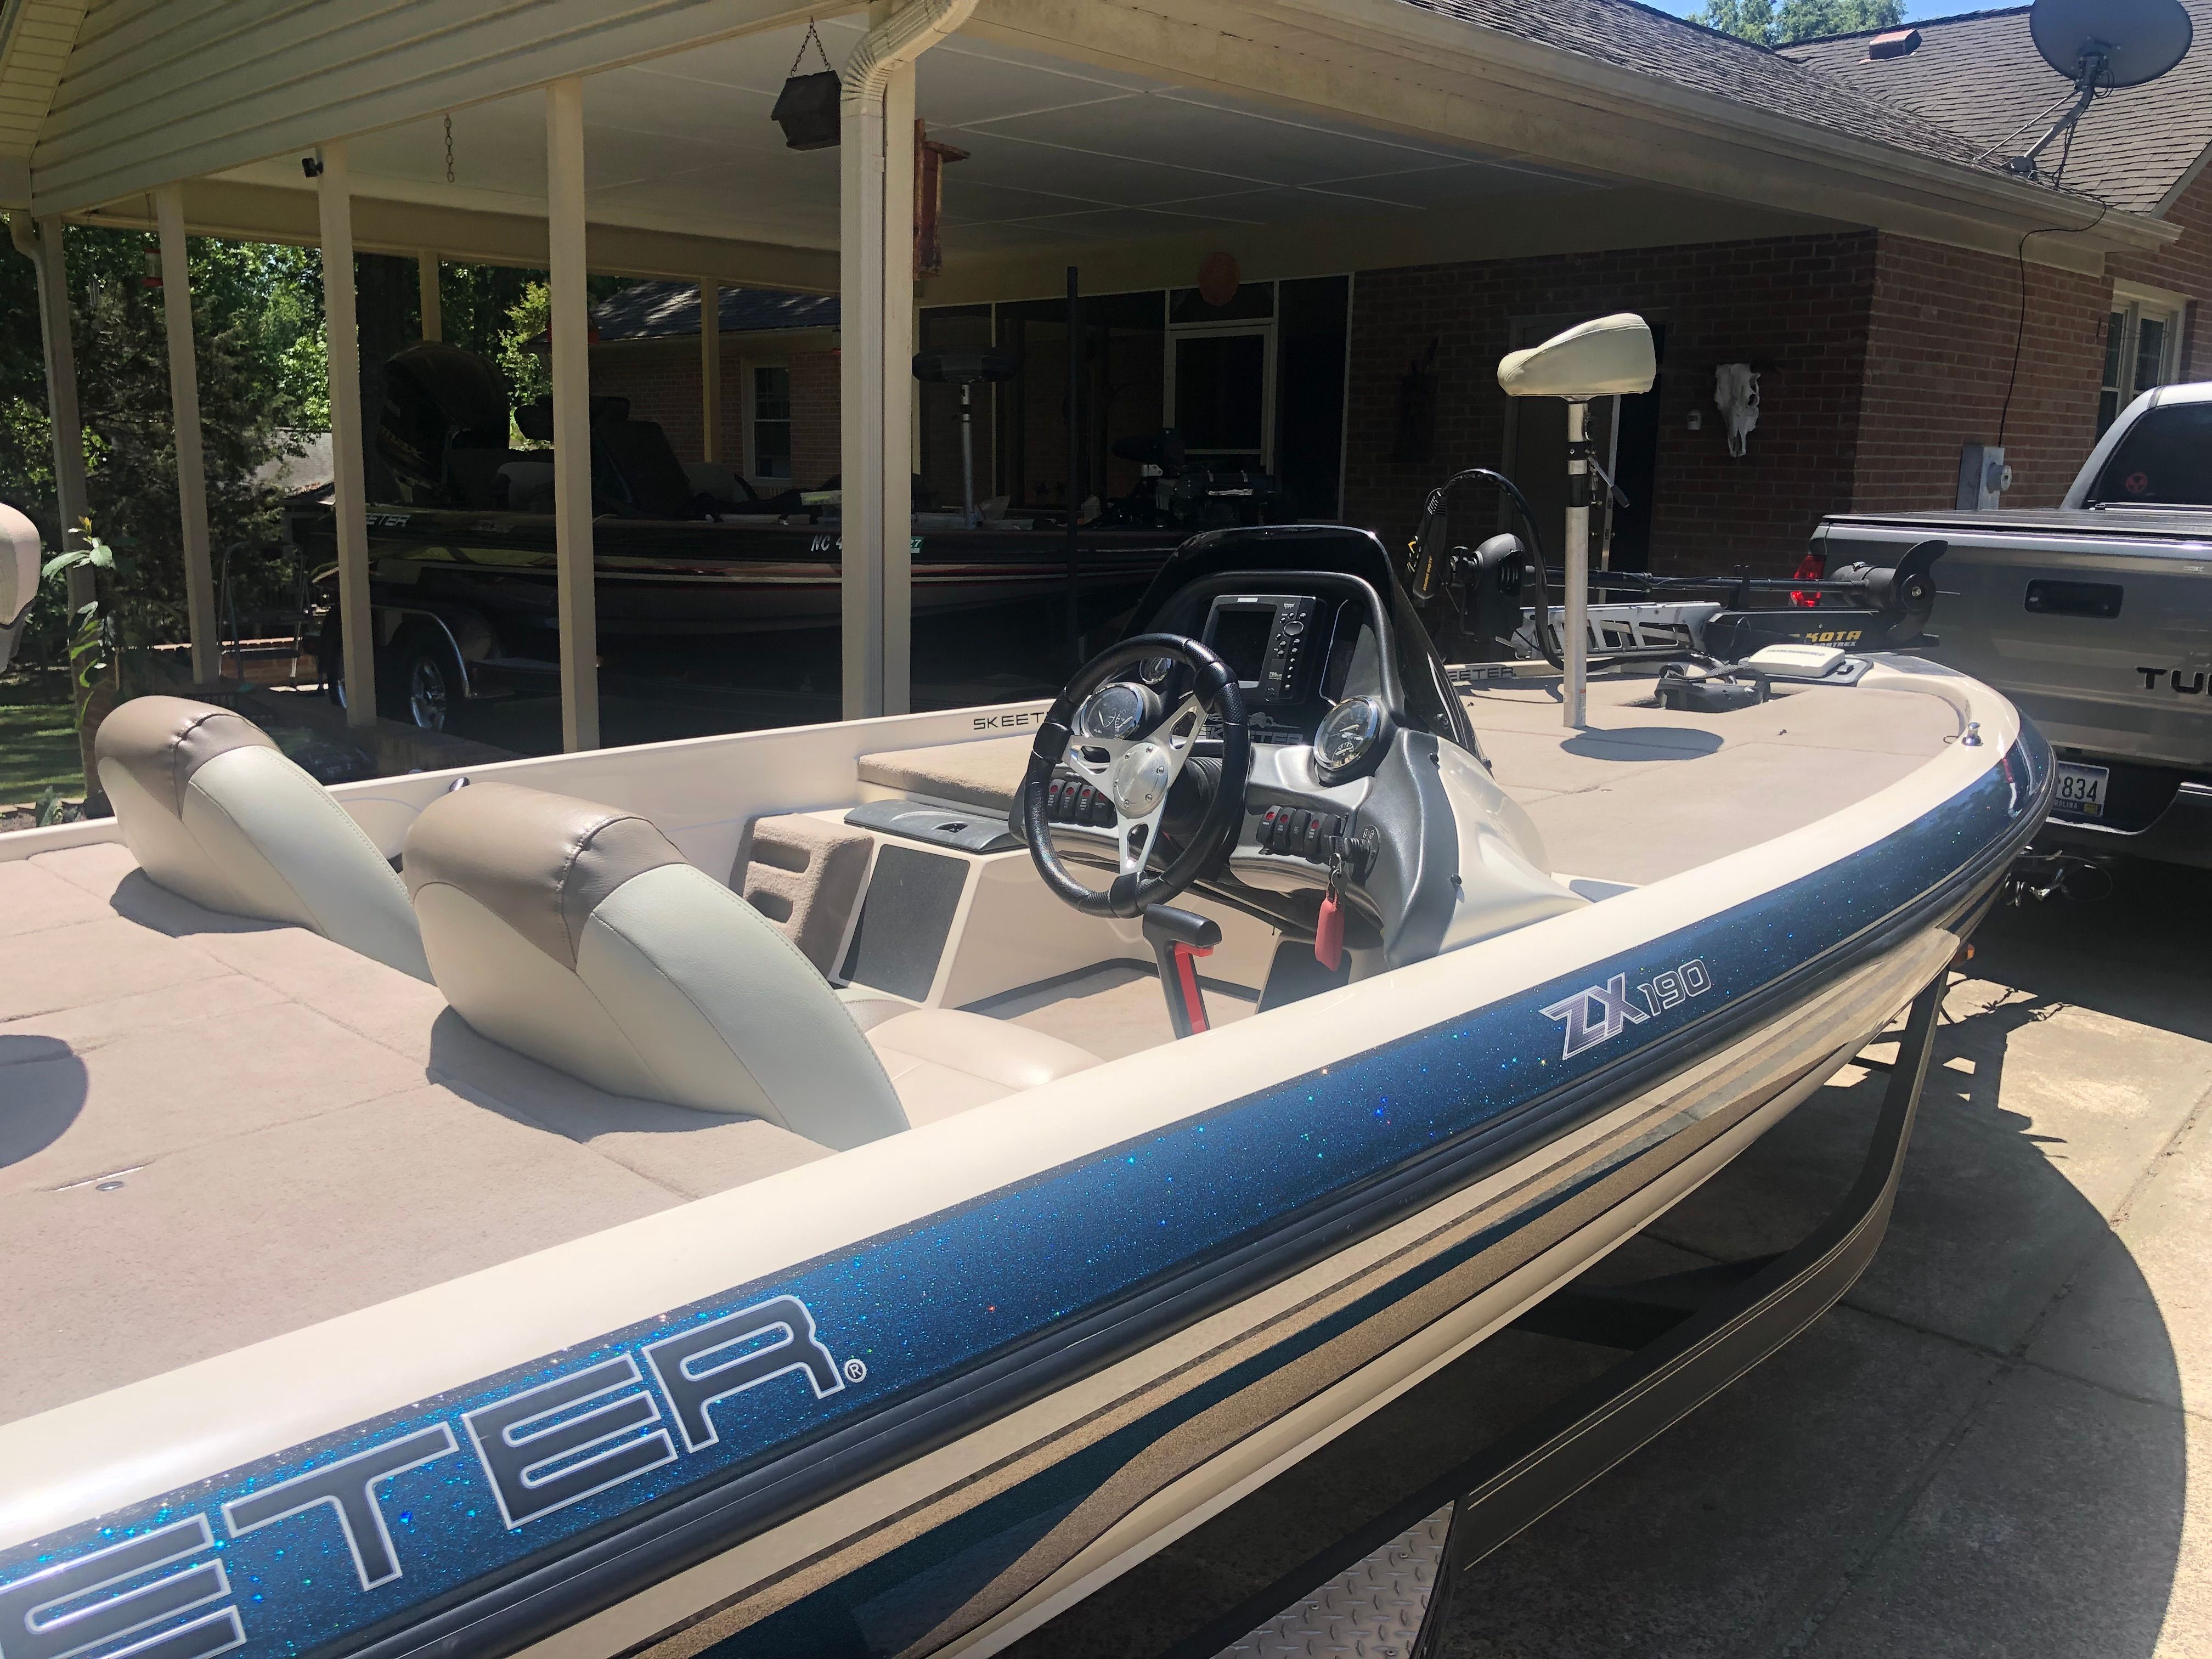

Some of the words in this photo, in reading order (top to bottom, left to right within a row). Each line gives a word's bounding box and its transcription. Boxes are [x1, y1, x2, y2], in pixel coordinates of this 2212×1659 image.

[810, 534, 831, 552] NC
[2136, 666, 2212, 696] TU
[973, 712, 1049, 730] SKEET
[2059, 776, 2098, 802] 834
[1637, 959, 1712, 1016] 190
